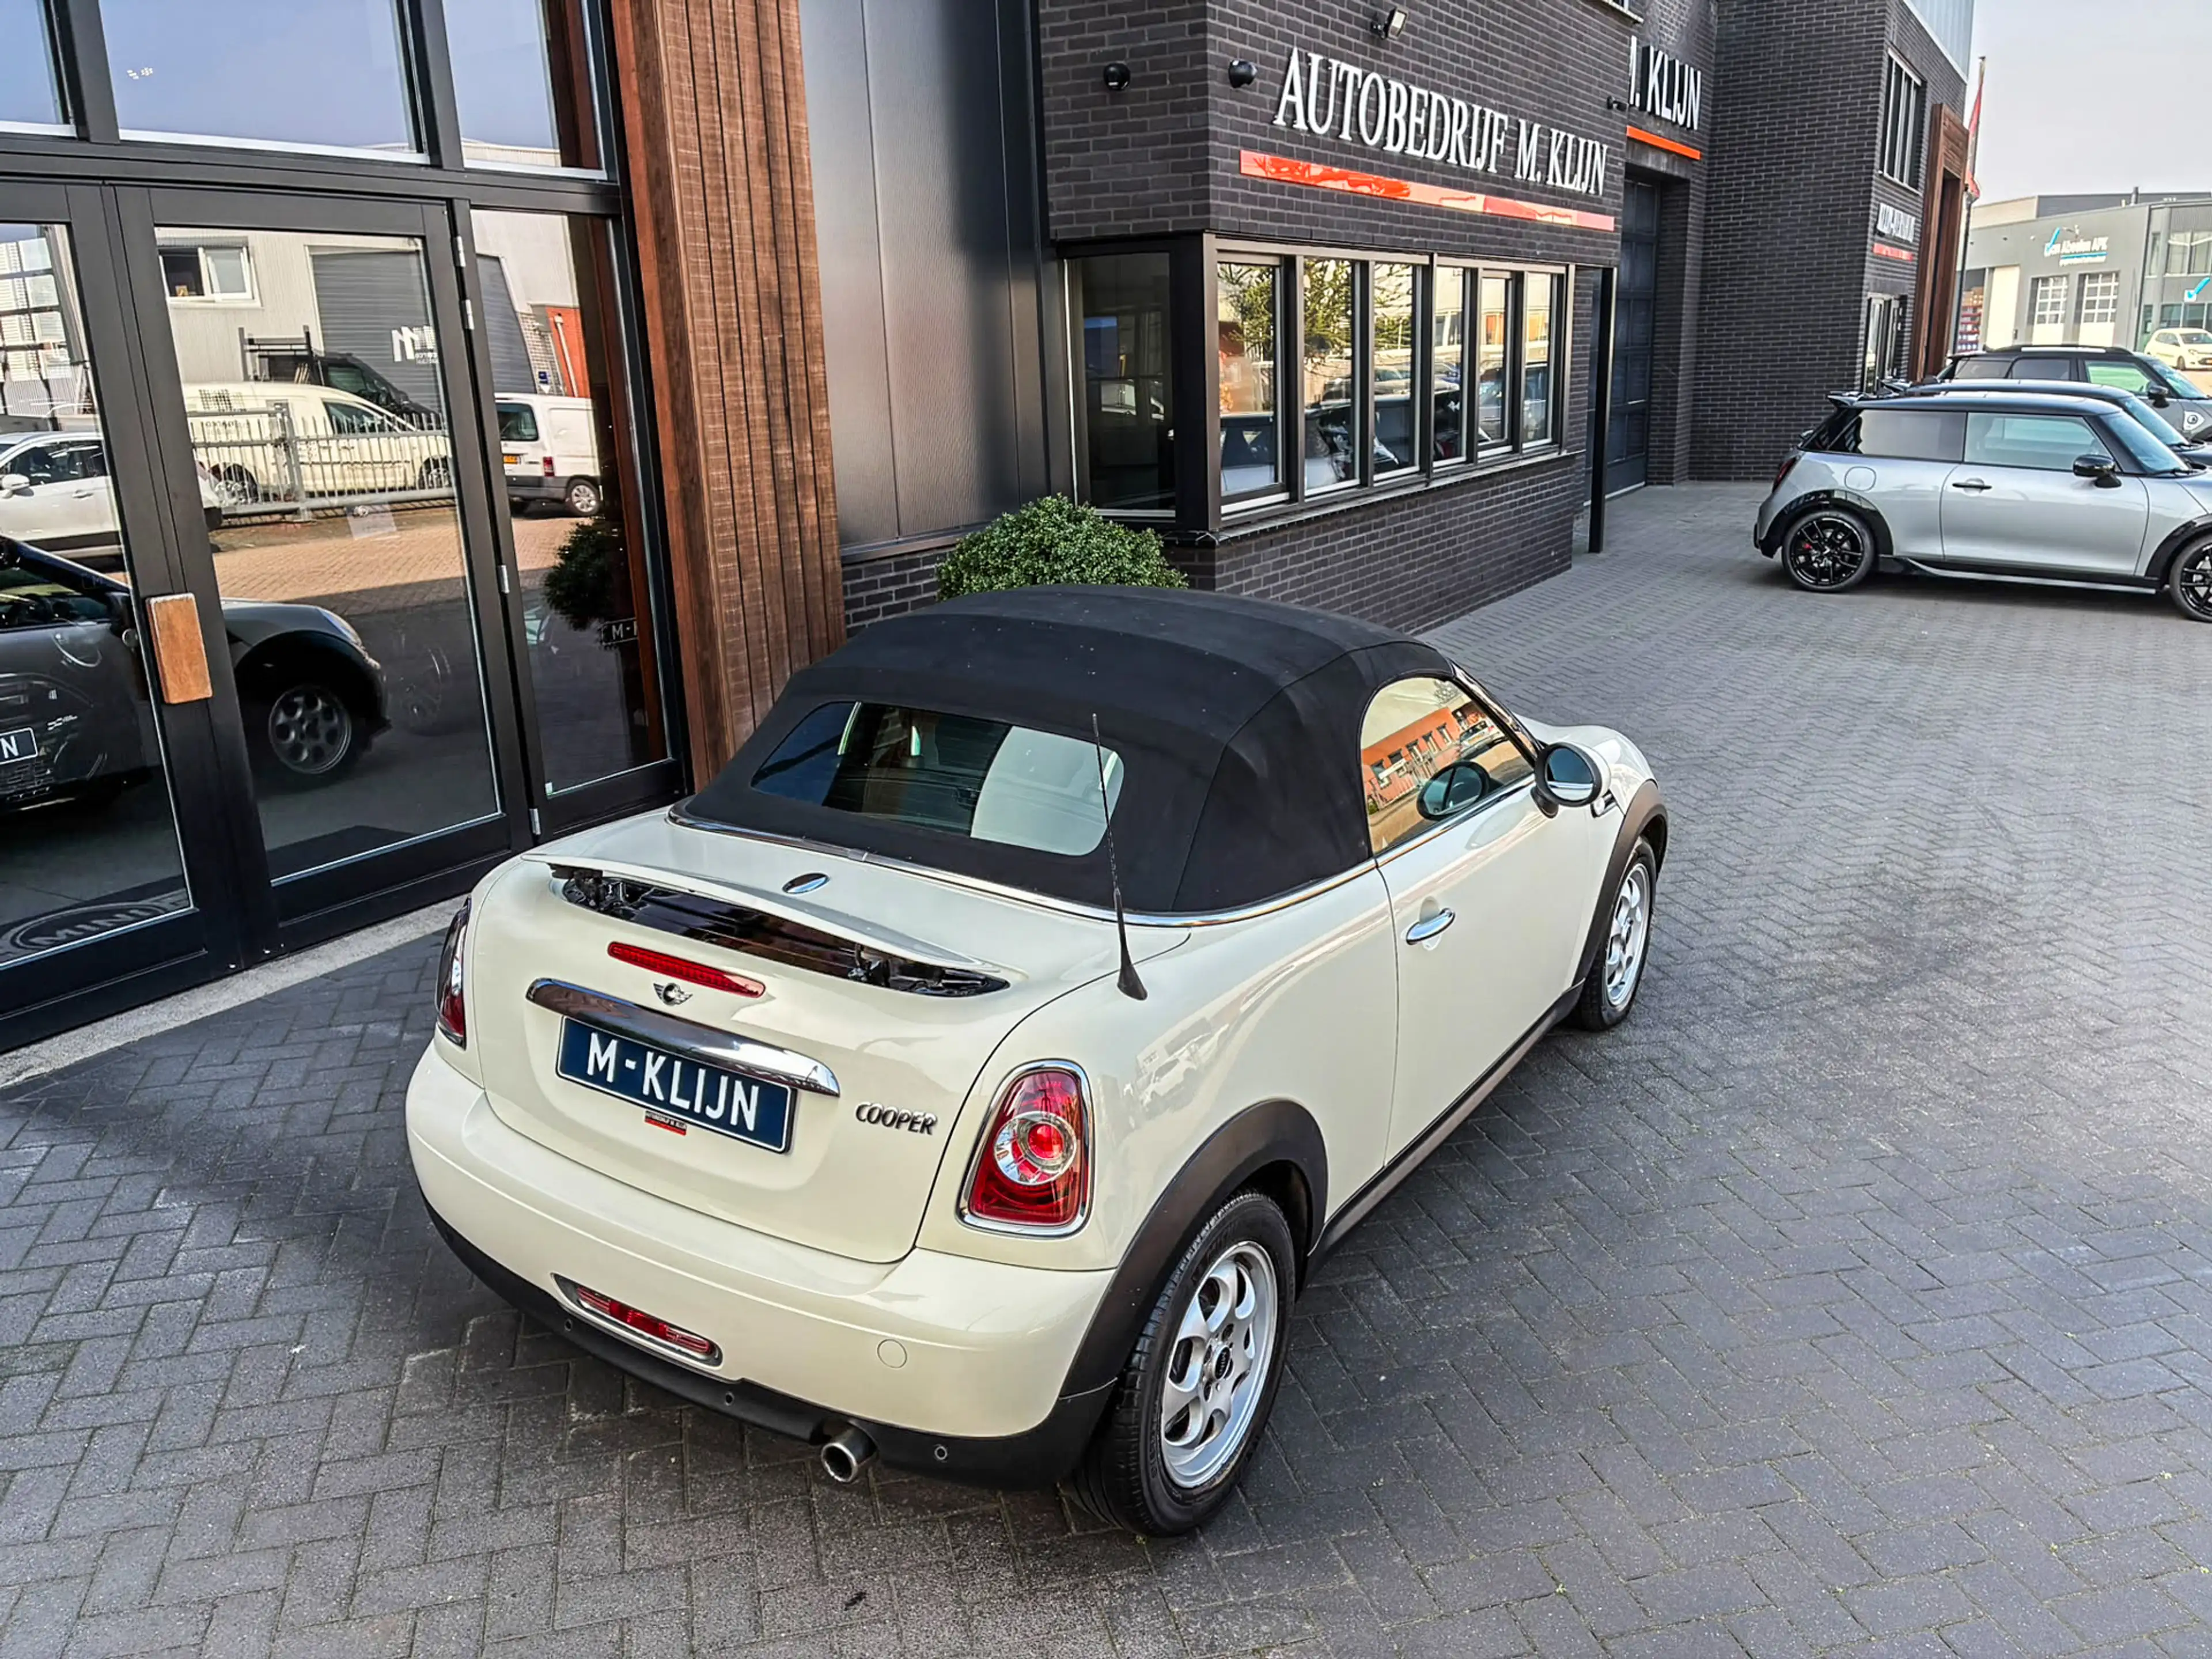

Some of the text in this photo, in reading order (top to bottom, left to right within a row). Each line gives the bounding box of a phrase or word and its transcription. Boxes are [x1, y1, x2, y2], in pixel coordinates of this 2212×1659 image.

[1274, 47, 1609, 196] AUTOBEDRIJF M. KLIJN
[1646, 46, 1702, 131] KLIJN
[29, 908, 151, 945] MINI
[586, 1032, 759, 1131] M-KLIJN
[855, 1101, 938, 1136] COOPER
